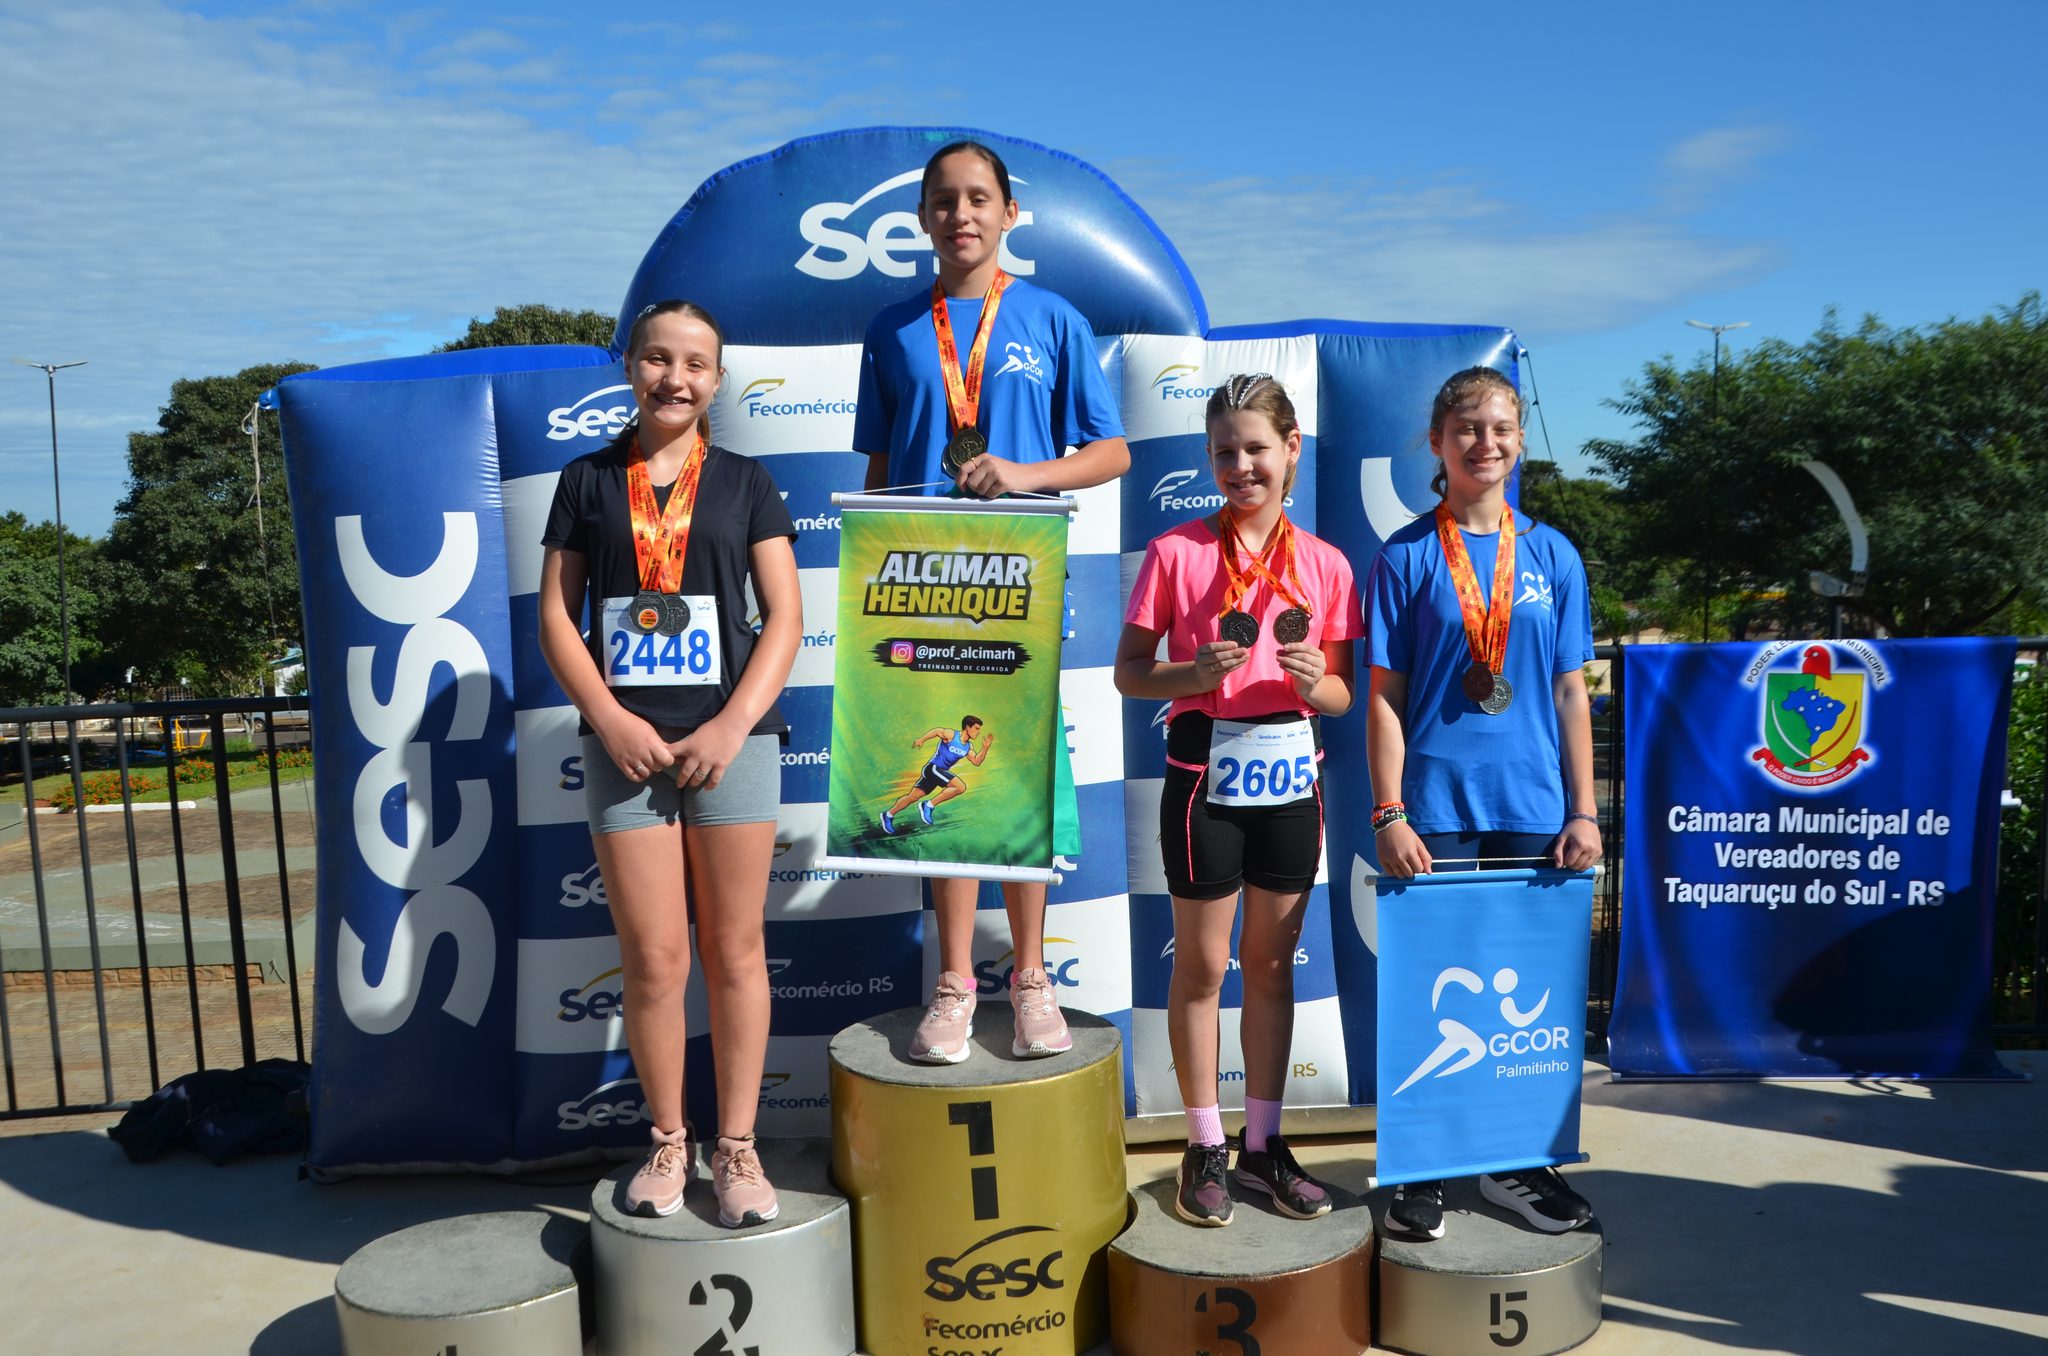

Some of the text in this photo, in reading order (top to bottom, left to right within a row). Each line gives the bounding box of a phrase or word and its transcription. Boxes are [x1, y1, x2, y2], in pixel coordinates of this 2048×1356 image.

[795, 198, 1036, 280] Sec
[546, 406, 640, 441] Ses
[879, 553, 1029, 586] ALCIMAR
[867, 584, 1027, 620] HENRIQUE
[609, 629, 712, 676] 2448
[915, 645, 1016, 661] @prof_alcimarh
[918, 663, 961, 671] TREINADOR
[1746, 649, 1775, 683] PODER
[1846, 640, 1886, 684] MUNICIPAL
[1216, 755, 1314, 798] 2605
[1668, 806, 1951, 840] Câmara Municipal de
[1714, 843, 1900, 871] Vereadores de
[1664, 877, 1796, 910] Taquaruçu
[1804, 879, 1837, 904] do
[1844, 880, 1885, 906] Sul
[1907, 880, 1945, 906] RS
[769, 976, 894, 998] ecomércio RS
[1489, 1027, 1570, 1057] GCOR
[1293, 1062, 1318, 1078] RS
[1496, 1060, 1570, 1079] Palmitinho
[758, 1093, 829, 1109] Fecomé
[948, 1101, 999, 1221] 1
[924, 1246, 1065, 1302] Sesc
[689, 1274, 759, 1356] 2
[924, 1309, 1066, 1339] Fecomércio
[1195, 1287, 1261, 1356] 3
[1489, 1291, 1528, 1347] 5
